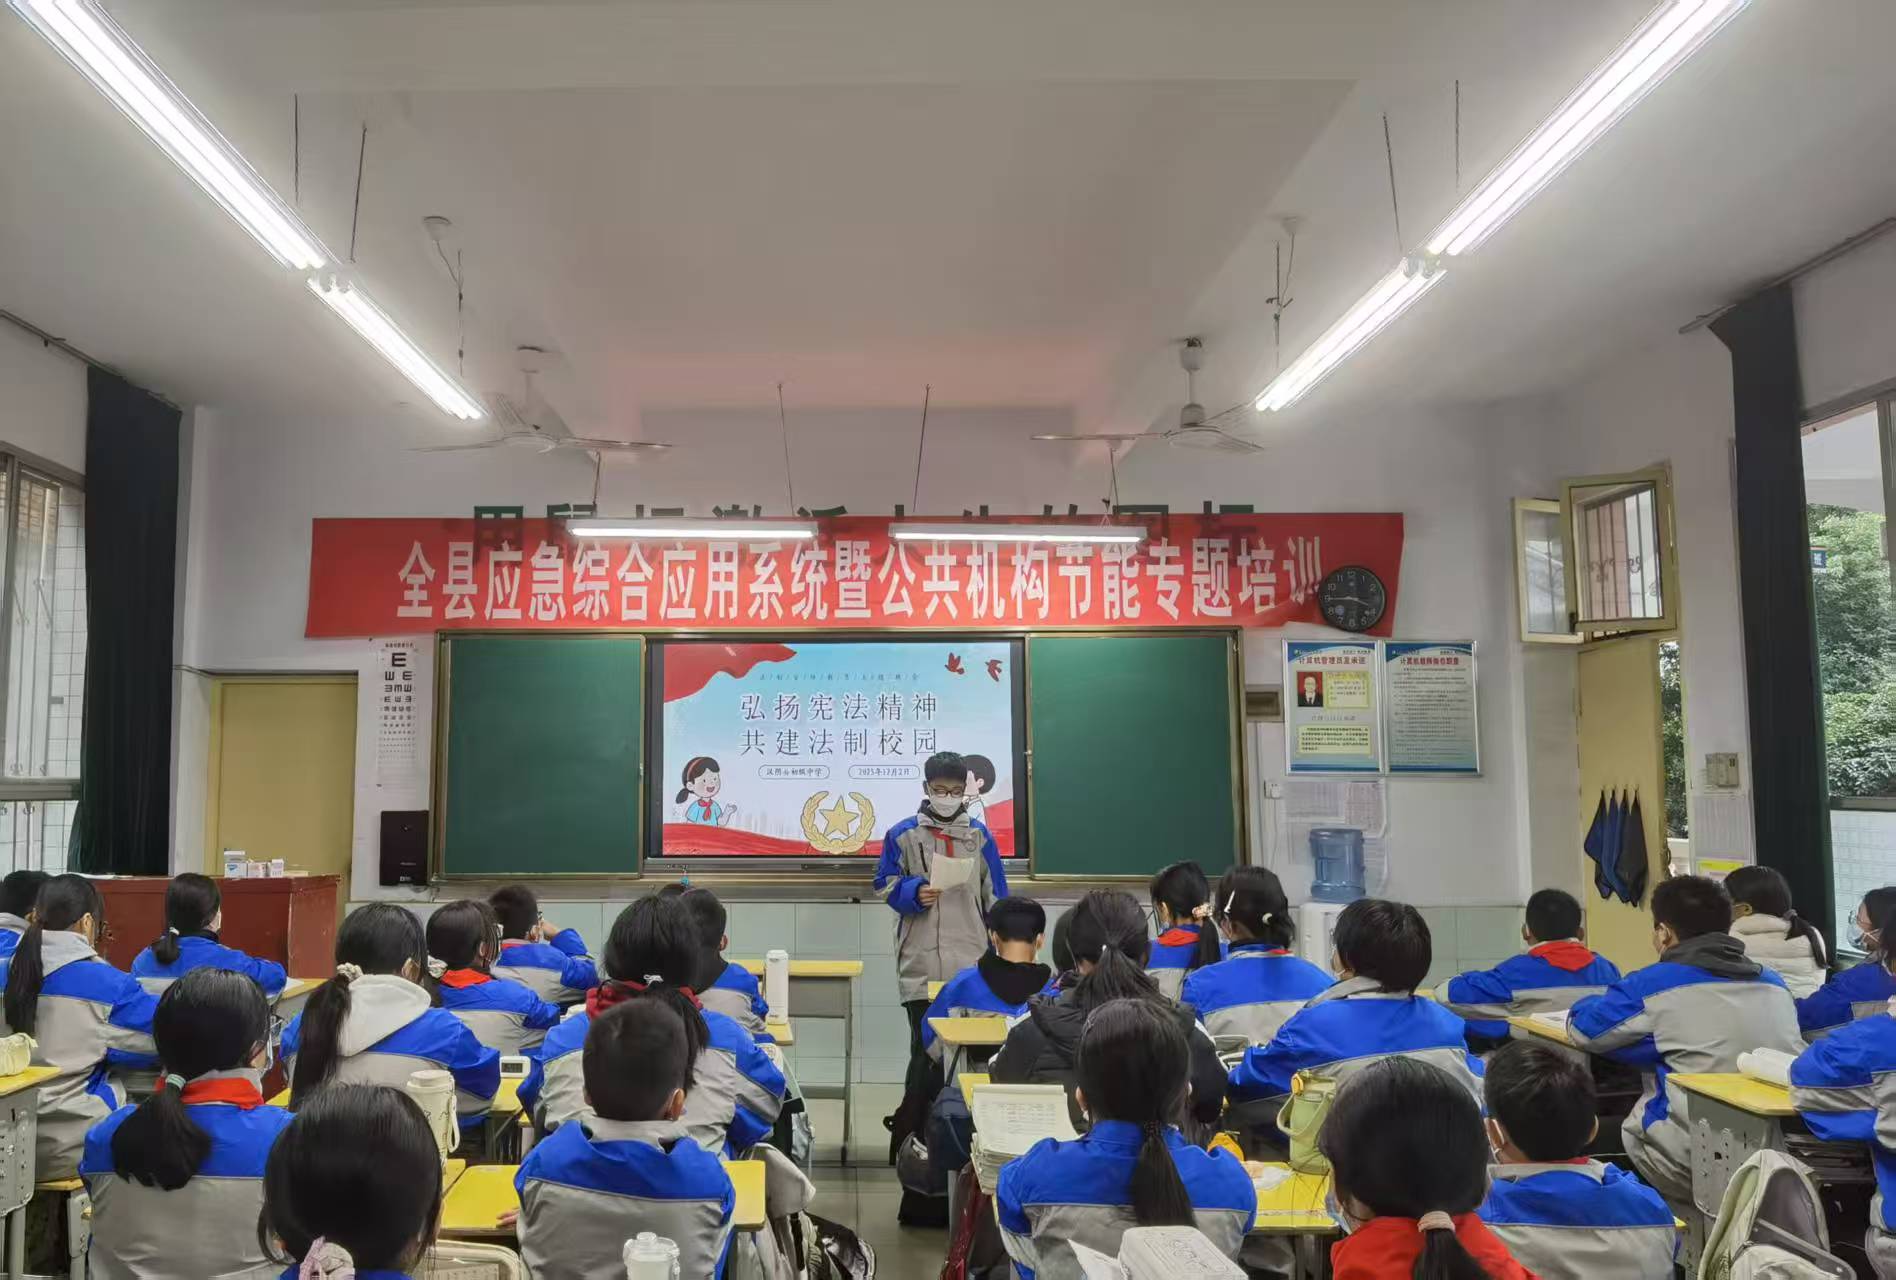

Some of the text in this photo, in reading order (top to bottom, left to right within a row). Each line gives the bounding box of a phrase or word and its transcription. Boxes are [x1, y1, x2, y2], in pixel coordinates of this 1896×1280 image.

[397, 536, 1322, 620] 全县应急综合应用系统暨公共机构节能专题培训
[740, 692, 936, 721] 弘扬宪法精神
[740, 728, 936, 755] 共建法制校园
